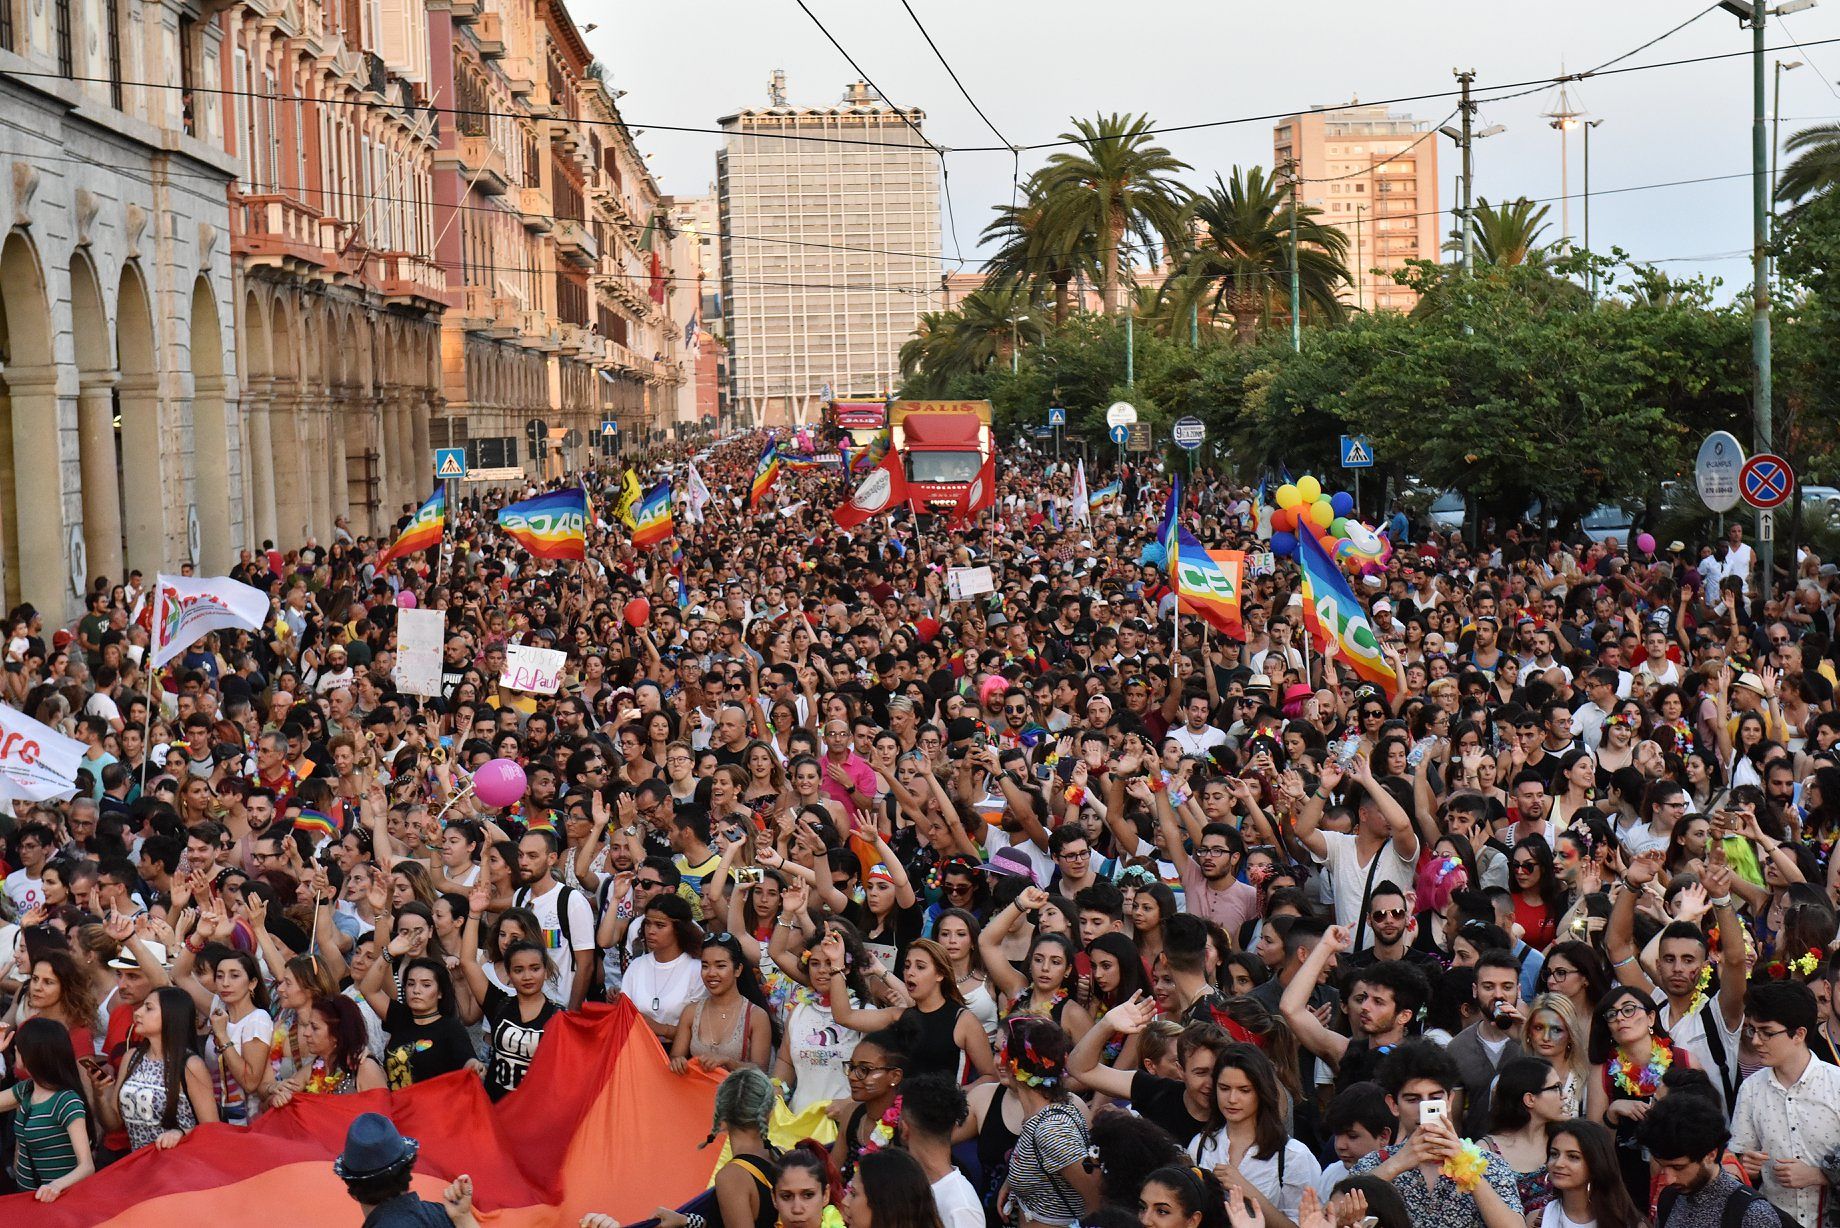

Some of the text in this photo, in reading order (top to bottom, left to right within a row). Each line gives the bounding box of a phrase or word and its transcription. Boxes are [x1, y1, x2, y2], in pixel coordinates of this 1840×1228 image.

[899, 402, 976, 412] SALIS
[512, 666, 560, 690] RuPaul
[800, 1050, 843, 1059] DEMISEXUAL
[119, 1085, 154, 1120] 58
